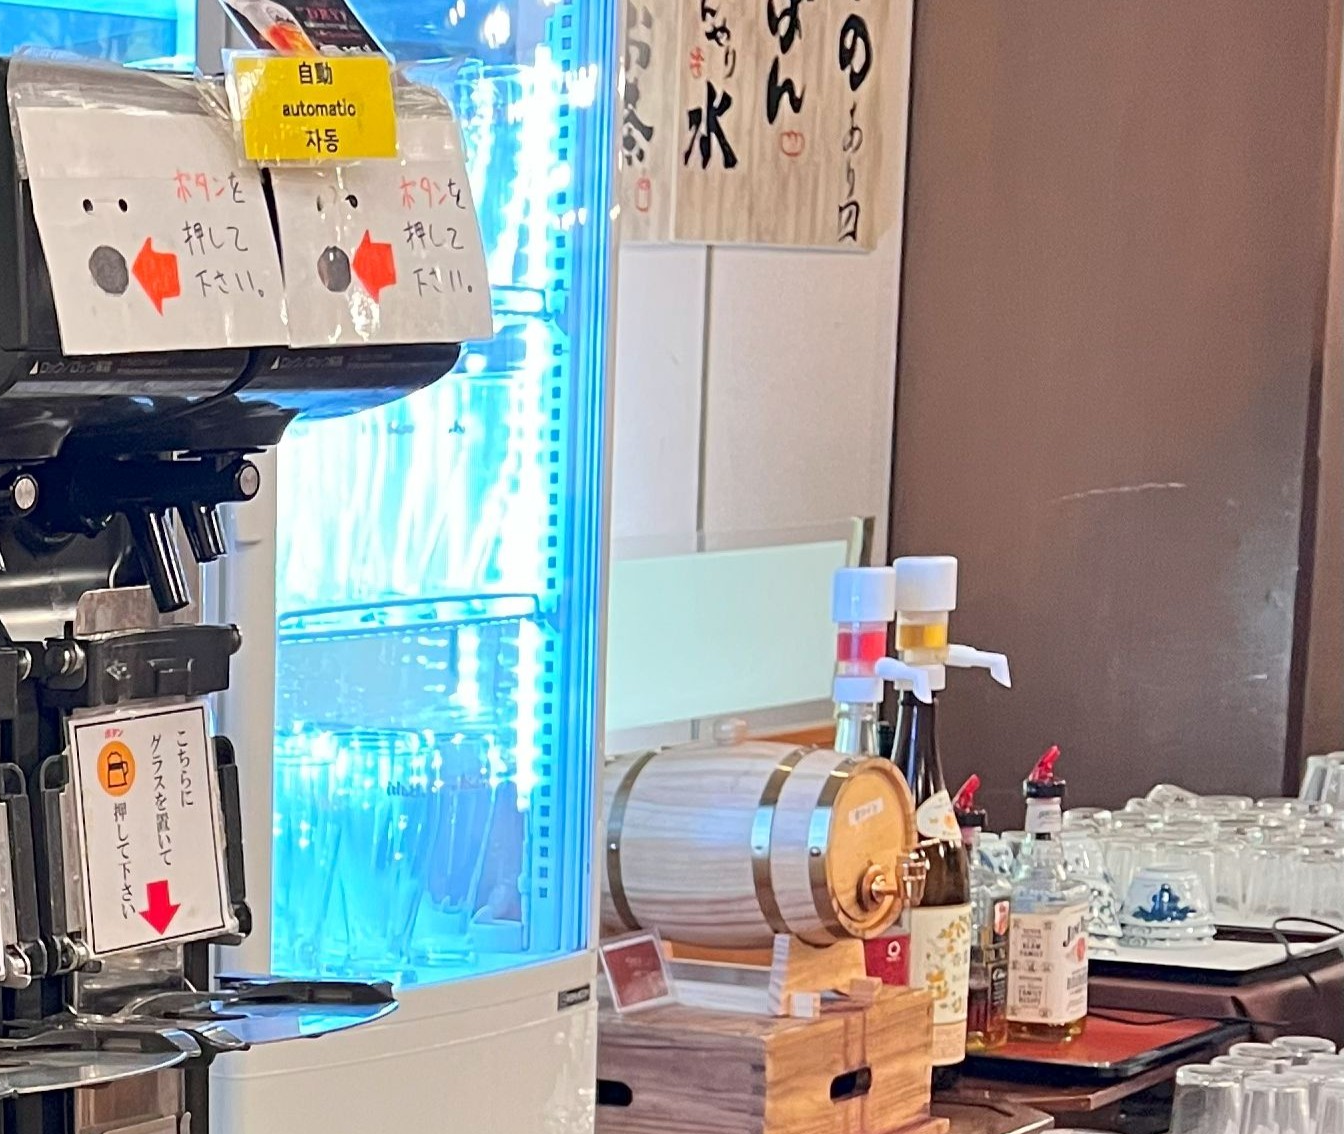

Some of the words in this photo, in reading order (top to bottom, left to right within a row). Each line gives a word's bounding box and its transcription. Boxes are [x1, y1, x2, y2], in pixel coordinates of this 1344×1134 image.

[298, 63, 333, 87] 自動
[282, 100, 357, 118] automatic
[305, 129, 339, 154] 자동
[182, 221, 249, 254] 押して
[405, 222, 465, 251] 押して
[195, 269, 266, 299] 下さい。
[176, 730, 194, 808] こちらに
[150, 734, 173, 867] グラスを置いて
[112, 802, 137, 919] 押して下さい
